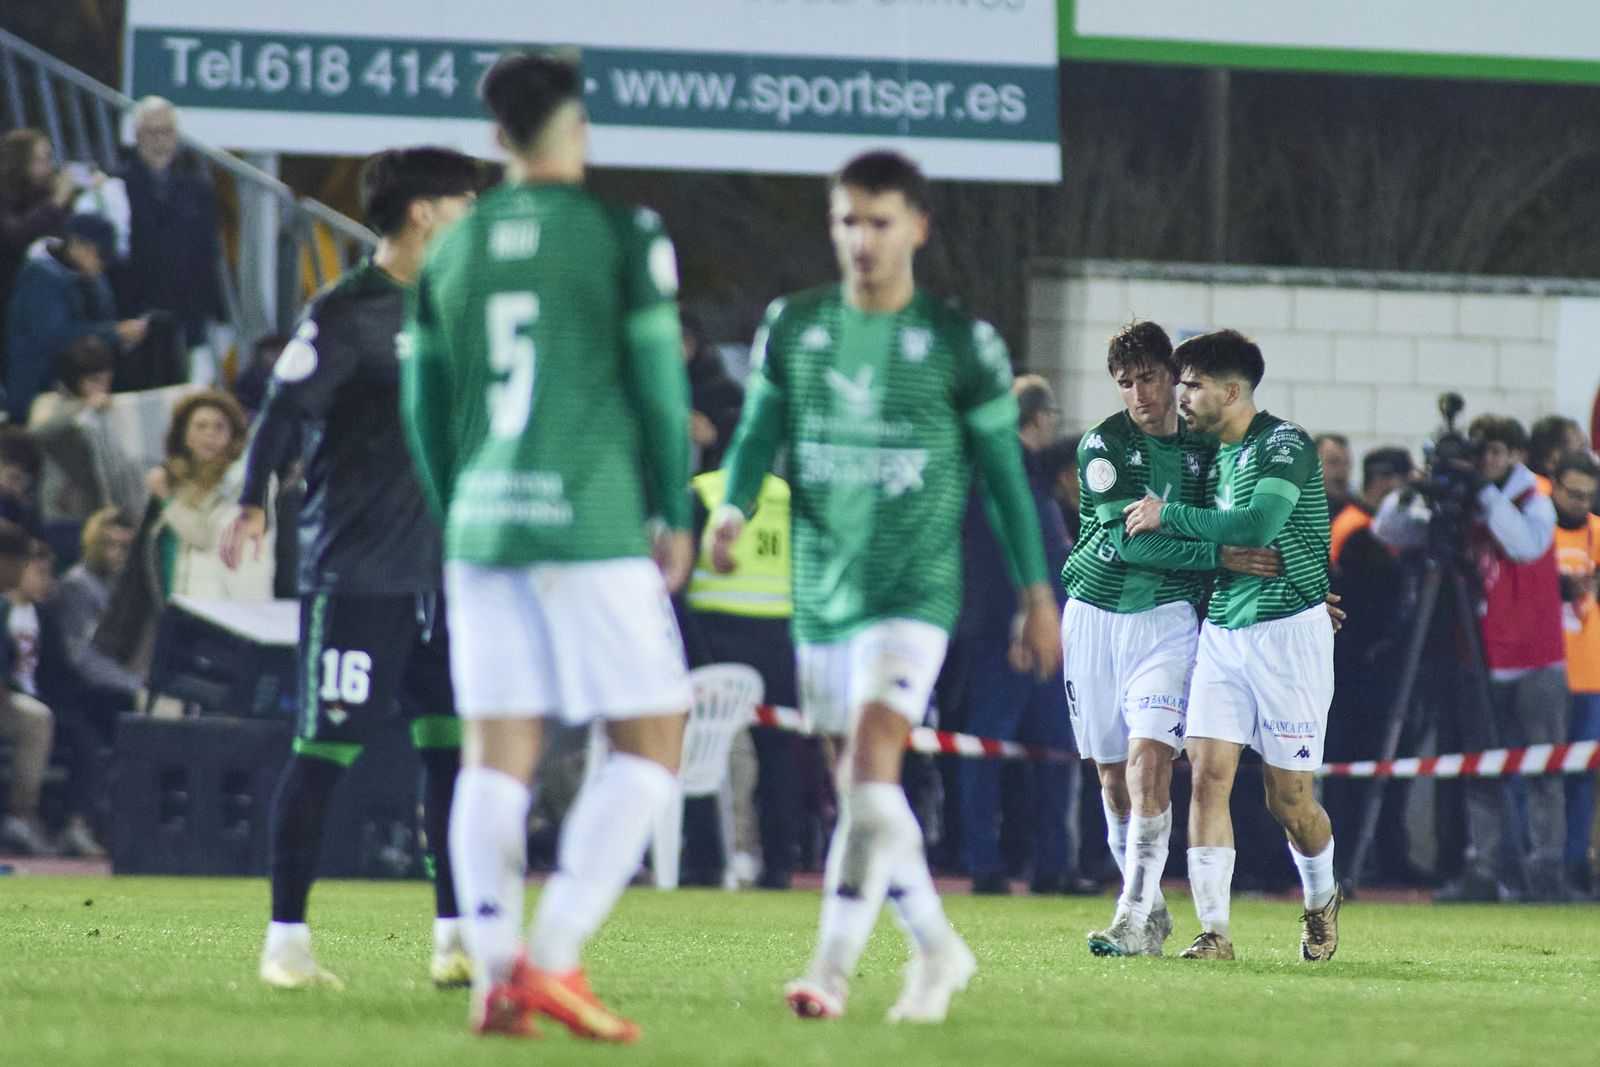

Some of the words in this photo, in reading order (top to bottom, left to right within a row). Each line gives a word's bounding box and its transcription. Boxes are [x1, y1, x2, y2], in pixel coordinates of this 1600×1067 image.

[361, 48, 458, 96] 414
[611, 68, 1027, 124] www.sportser.es
[486, 290, 540, 440] 5
[320, 648, 372, 705] 16
